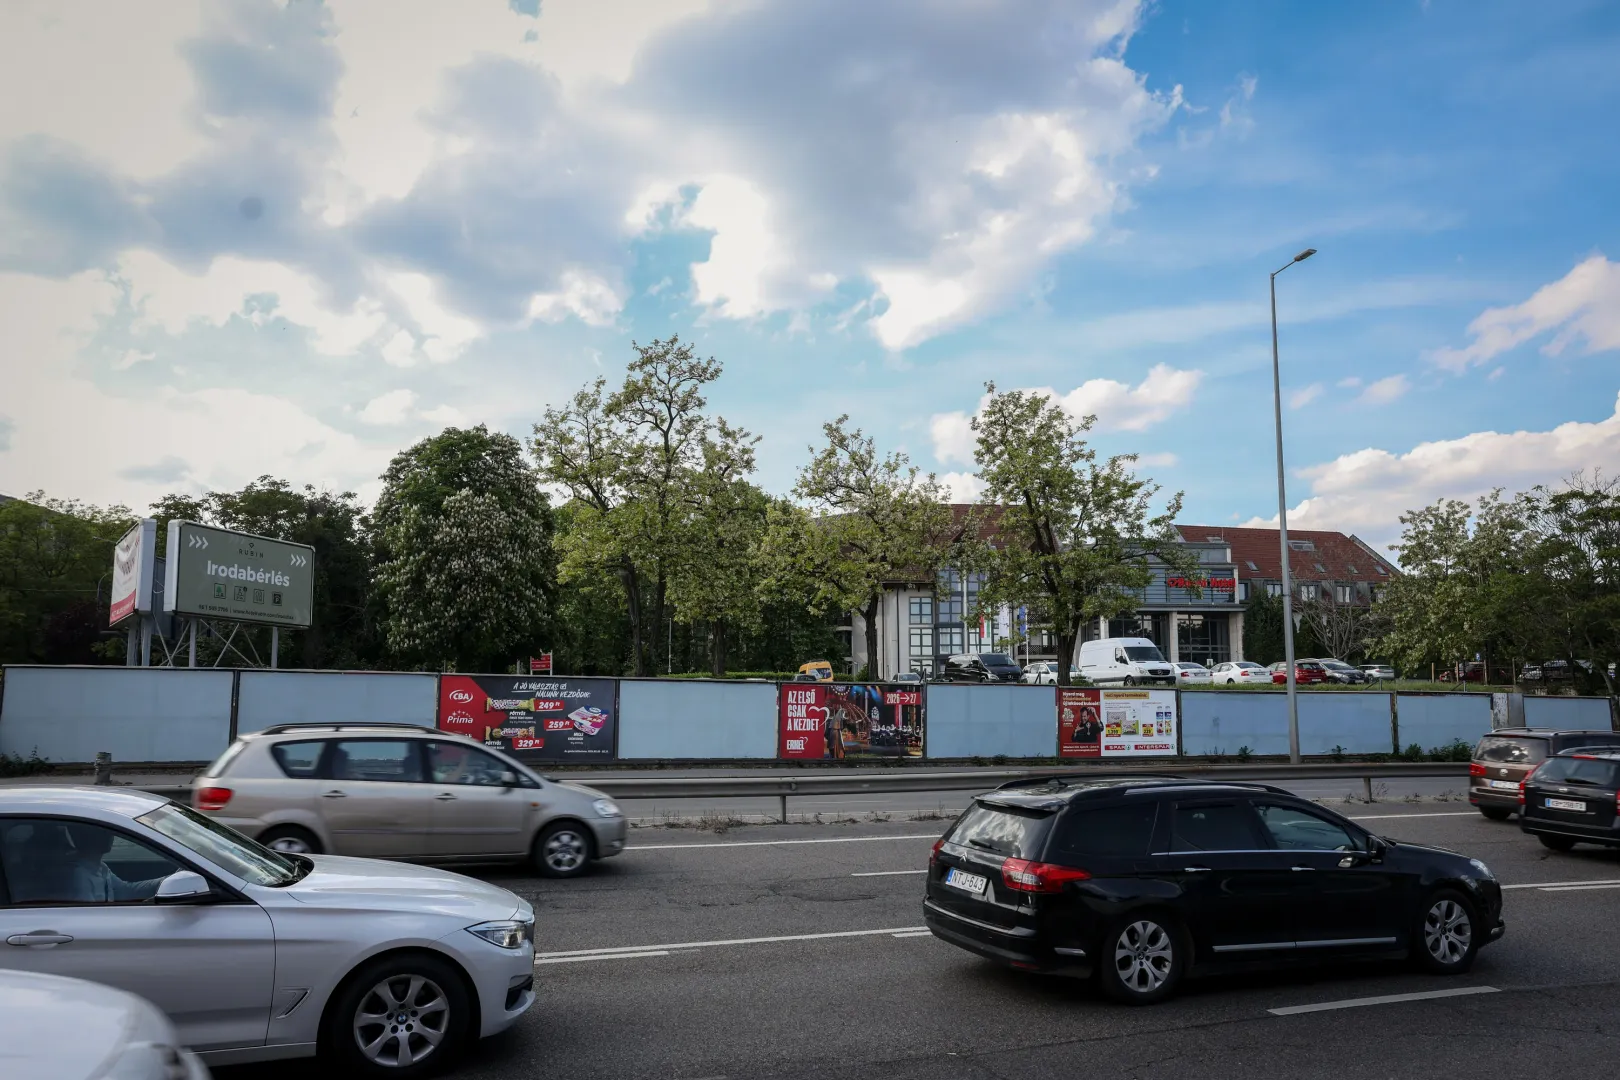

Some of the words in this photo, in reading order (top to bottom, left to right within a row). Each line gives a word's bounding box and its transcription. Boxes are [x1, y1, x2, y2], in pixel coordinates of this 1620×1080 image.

[239, 548, 264, 559] RUBIN
[207, 560, 290, 587] Irodabérlés
[513, 682, 519, 690] A
[519, 681, 528, 690] JÓ
[528, 681, 560, 691] VÁLASZTÁS
[453, 692, 470, 700] CBA
[535, 690, 560, 698] NÁLUNK
[787, 690, 798, 704] AZ
[798, 688, 816, 704] ELSŐ
[886, 693, 900, 704] 2026
[909, 693, 917, 704] 27
[538, 701, 554, 709] 249
[787, 704, 807, 718] CSAK
[548, 720, 563, 729] 259
[787, 718, 793, 731] A
[793, 718, 819, 731] KEZDET
[517, 739, 533, 747] 329
[952, 871, 984, 891] NTJ-643
